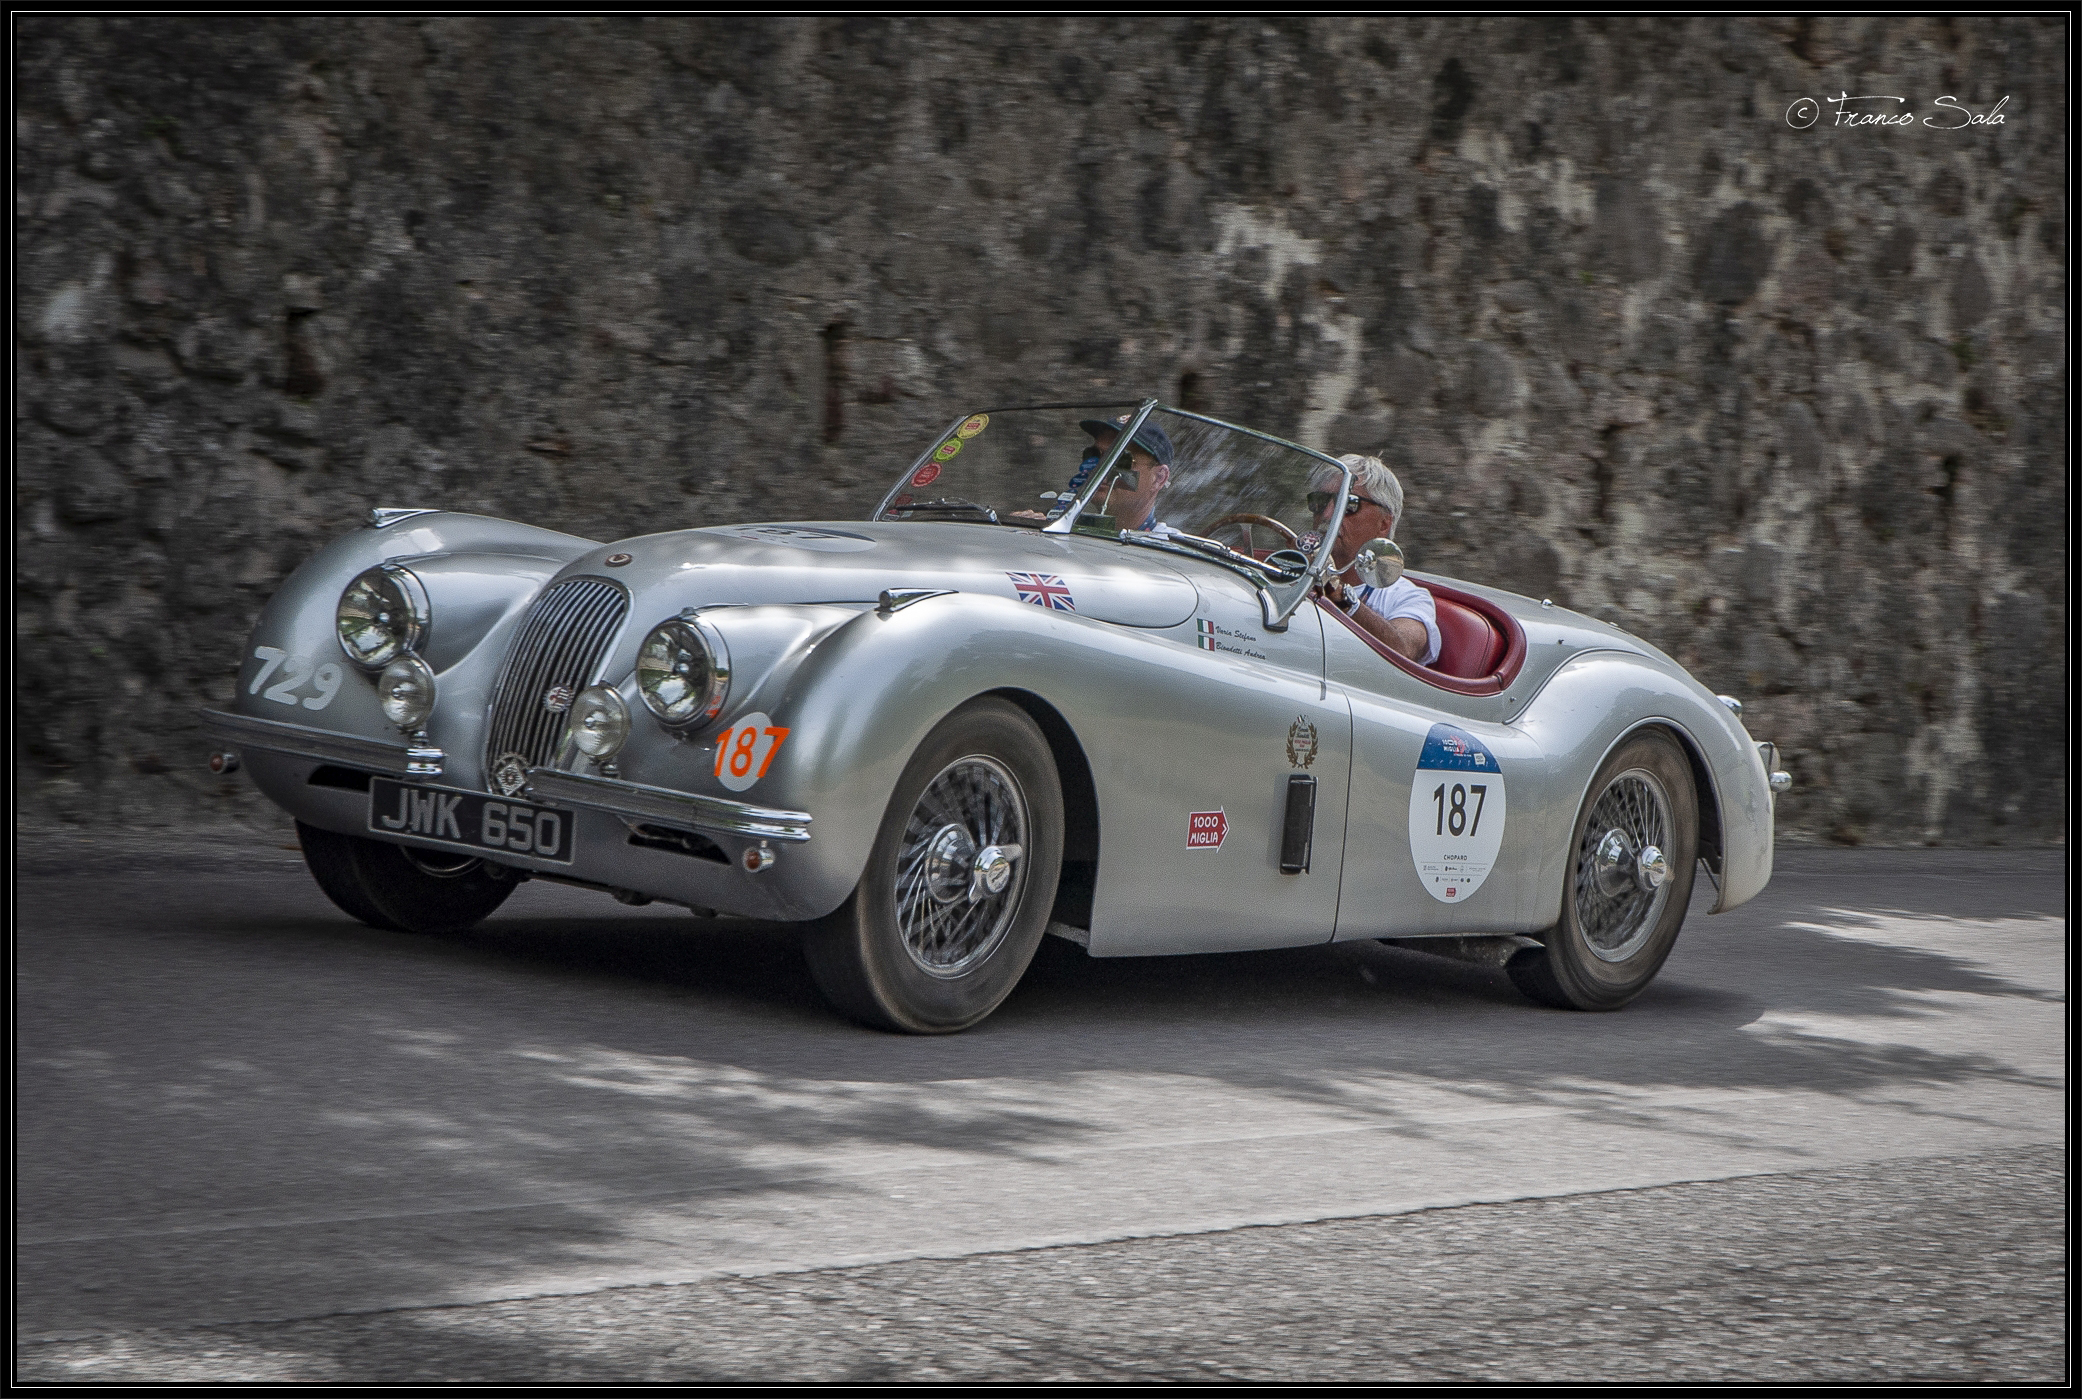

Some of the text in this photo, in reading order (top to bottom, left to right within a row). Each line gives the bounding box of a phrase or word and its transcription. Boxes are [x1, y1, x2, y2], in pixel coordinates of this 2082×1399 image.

[250, 645, 344, 711] 729
[714, 726, 791, 778] 187
[381, 787, 561, 856] JWK 650
[1193, 816, 1219, 828] 1000
[1433, 782, 1487, 836] 187
[1189, 831, 1219, 844] MIGLIA
